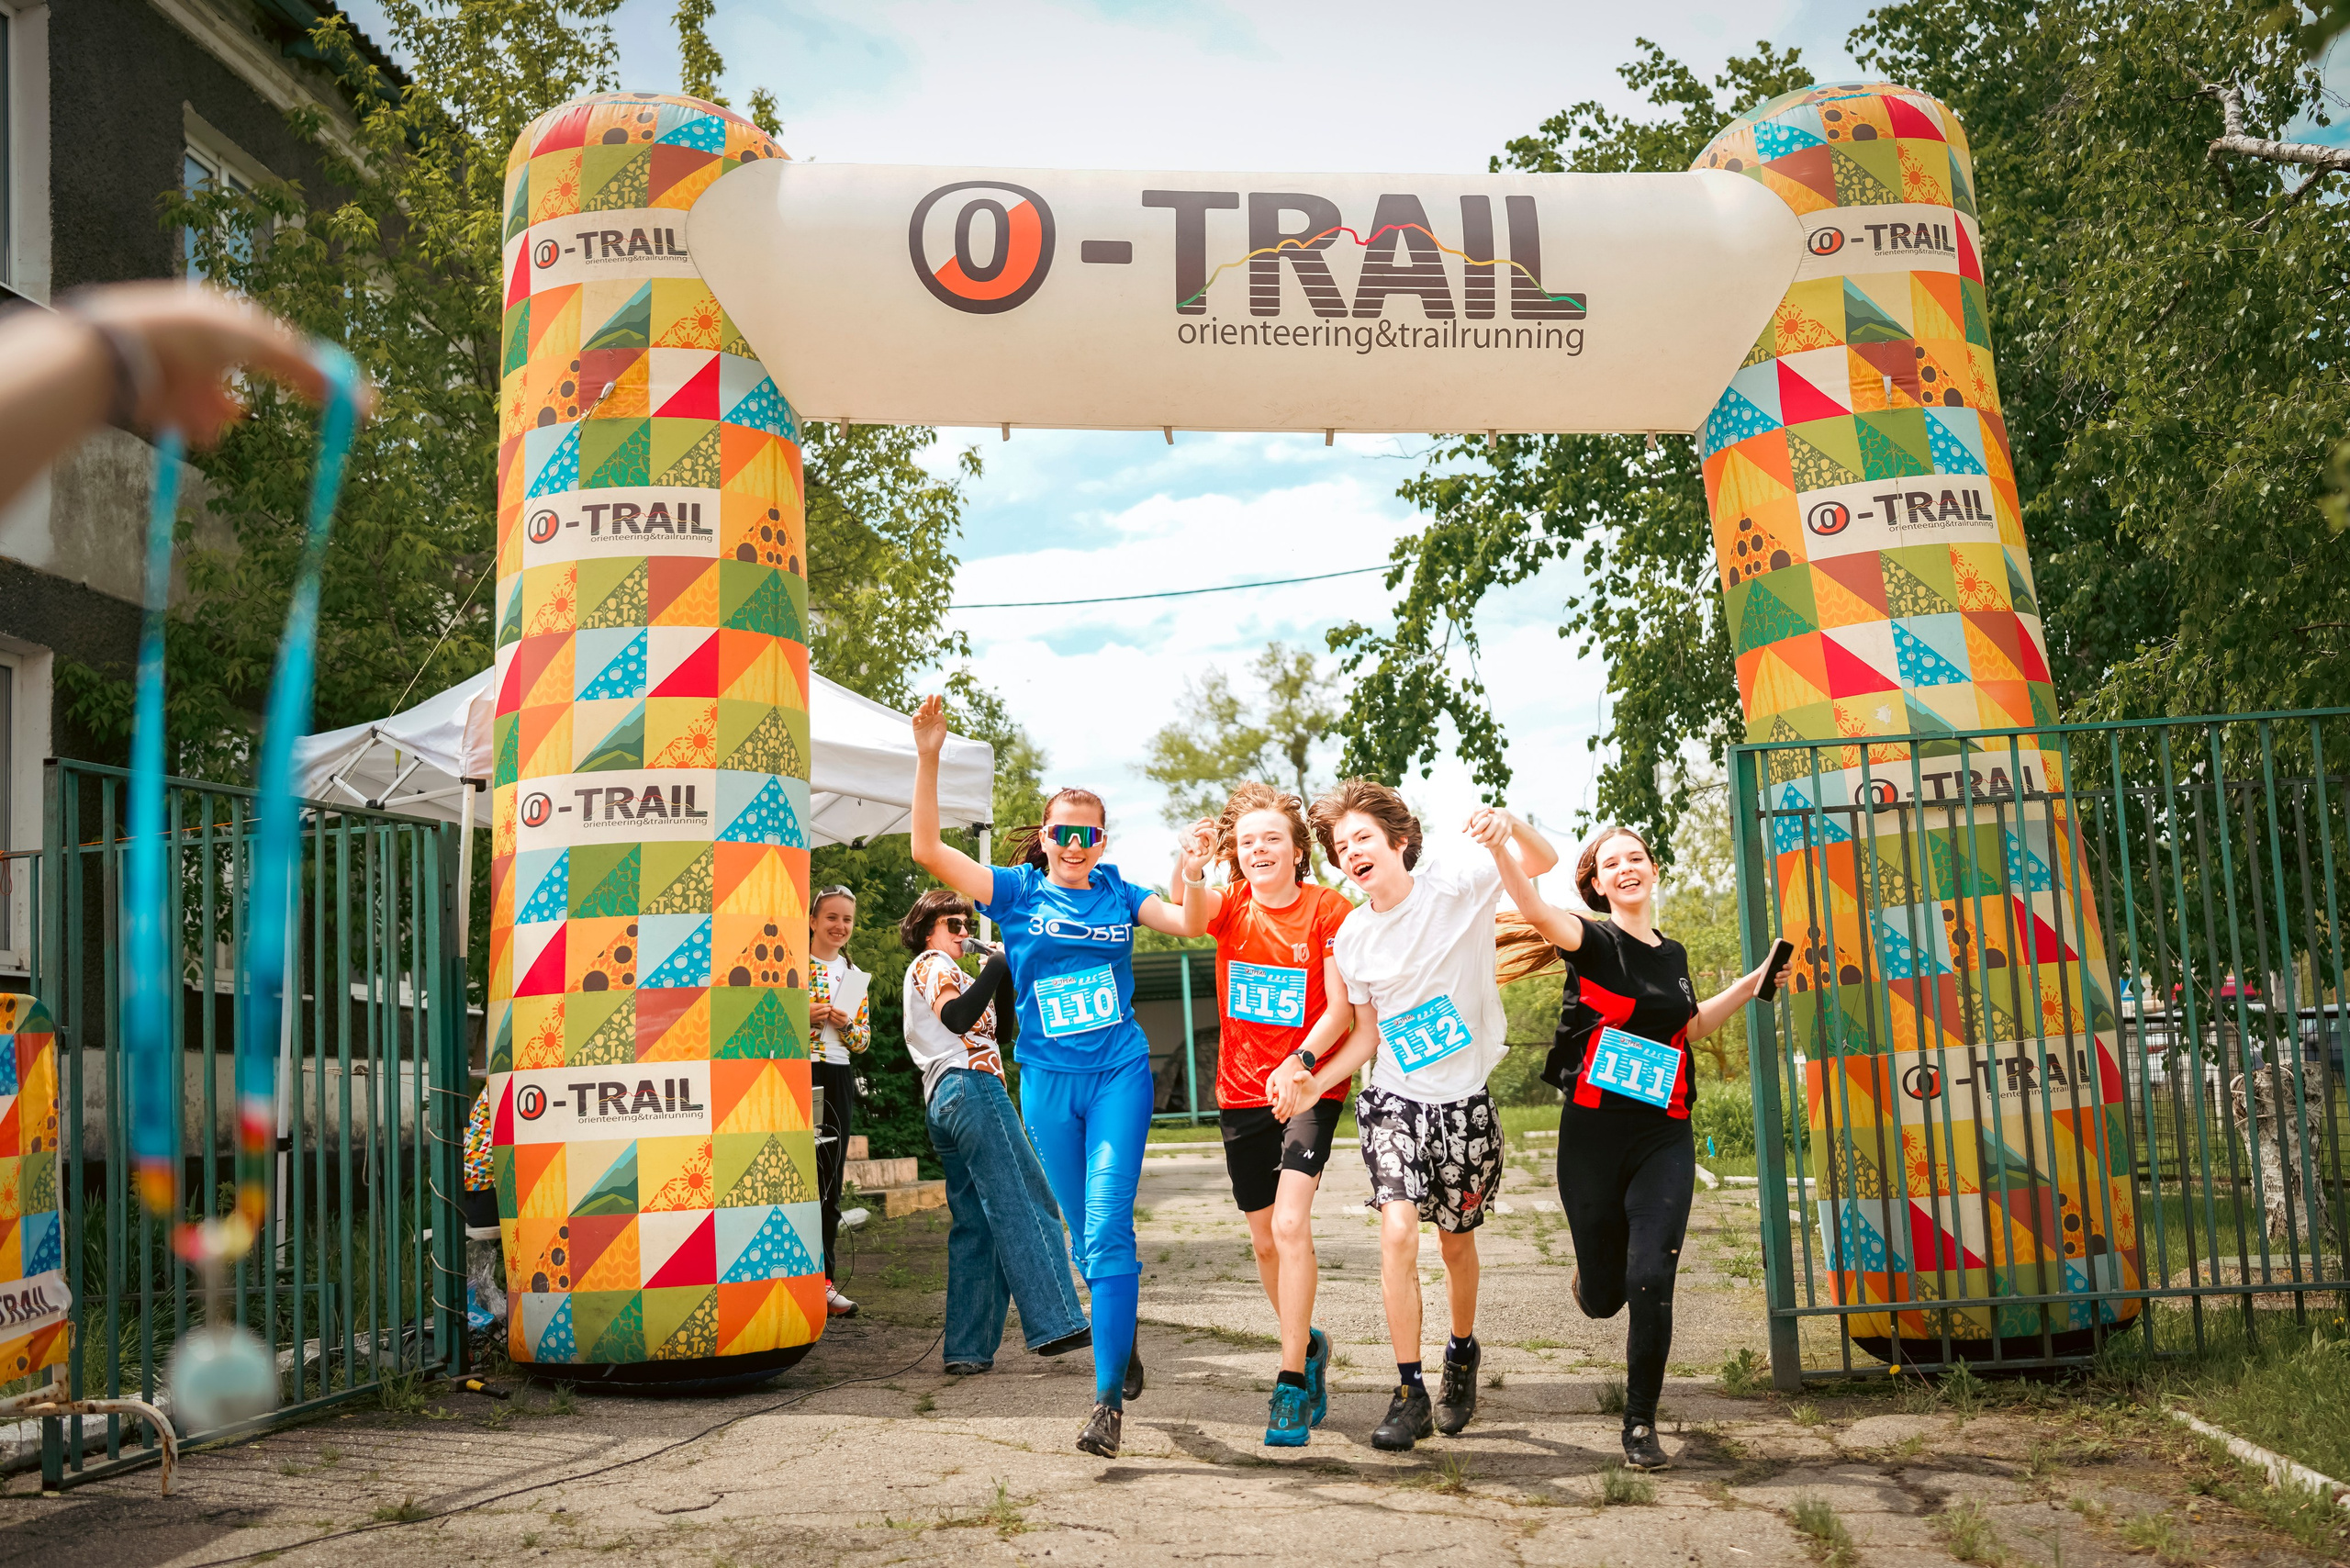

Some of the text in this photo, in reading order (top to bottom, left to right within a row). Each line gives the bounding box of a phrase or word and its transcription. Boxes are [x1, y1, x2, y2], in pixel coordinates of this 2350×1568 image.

[585, 254, 688, 265] orienteering&trailrunning
[1874, 246, 1956, 259] orienteering&trailrunning
[1178, 318, 1585, 356] orienteering&trailrunning
[590, 532, 713, 543] orienteering&trailrunning
[1889, 518, 1994, 532] orienteering&trailrunning
[1855, 766, 2044, 813] O-TRAL
[583, 816, 708, 829] orienteering&trailrunning
[1046, 986, 1114, 1028] 110
[1235, 982, 1300, 1020] 115
[1394, 1015, 1466, 1066] 112
[1596, 1051, 1667, 1099] 111
[577, 1110, 704, 1124] orienteering&trailrunning
[0, 1285, 60, 1326] RAIL
